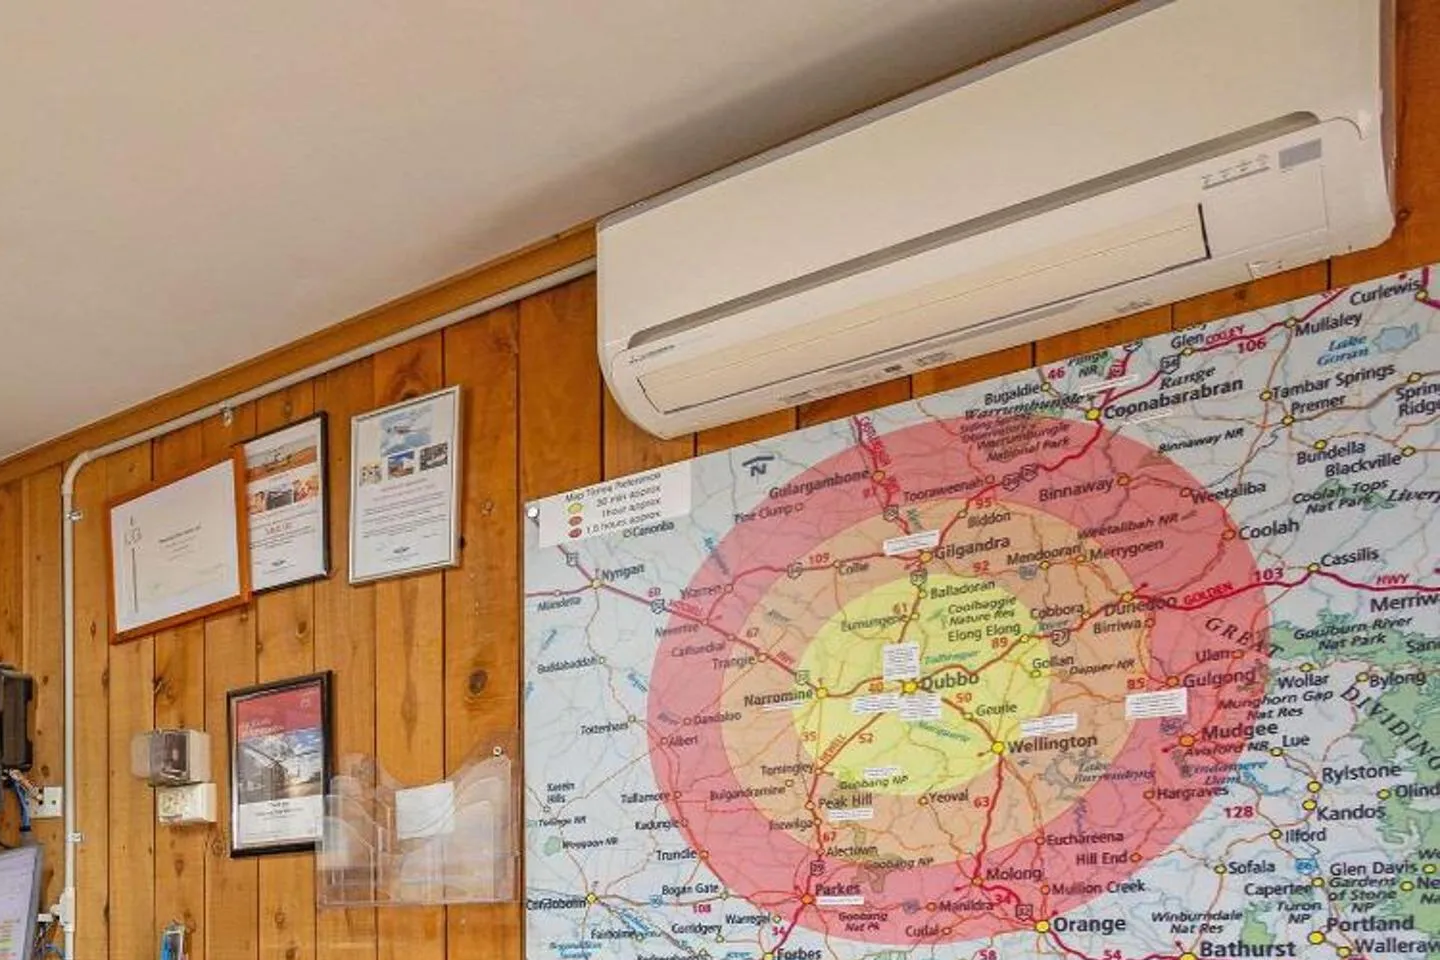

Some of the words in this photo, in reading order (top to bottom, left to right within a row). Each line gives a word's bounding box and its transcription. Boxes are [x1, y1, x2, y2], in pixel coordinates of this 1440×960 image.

[1349, 279, 1421, 306] Curlewis
[1295, 312, 1362, 337] Mullaley
[1170, 333, 1205, 351] Glen
[1238, 338, 1268, 354] 106
[1160, 366, 1216, 391] Range
[1272, 378, 1332, 401] Tambar
[1335, 362, 1396, 389] Springs
[983, 382, 1040, 406] Bugaldie
[1103, 378, 1244, 420] Coonabarabran
[1291, 394, 1347, 414] Premer
[1296, 442, 1366, 466] Bundella
[1325, 453, 1402, 478] Blackville
[768, 467, 872, 501] Gulargambone
[903, 476, 984, 502] Tooraweenah
[1038, 476, 1115, 502] Binnaway
[1191, 480, 1267, 505] Weetaliba
[1292, 488, 1343, 505] Coolah
[1346, 479, 1389, 495] Tops
[967, 511, 1012, 529] Biddon
[1238, 519, 1300, 541] Coolah
[932, 536, 1011, 560] Gilgandra
[1006, 542, 1083, 567] Mendooran
[1088, 538, 1165, 562] Merrygoen
[1320, 549, 1380, 568] Cassilis
[601, 563, 645, 583] Nyngan
[1253, 568, 1284, 583] 103
[1376, 573, 1409, 585] HWY
[929, 580, 996, 600] Balladoran
[1029, 603, 1084, 621] Cobbora
[1103, 597, 1178, 618] Dunedoo
[1093, 618, 1143, 635] Birriwa
[1372, 615, 1415, 631] River
[948, 629, 982, 643] Elong
[985, 623, 1022, 638] Elong
[1351, 632, 1387, 648] Park
[991, 636, 1009, 649] 89
[712, 655, 756, 671] Trangie
[1032, 654, 1075, 669] Gollan
[1195, 647, 1232, 664] Ulan
[921, 672, 980, 691] Dubbo
[1182, 667, 1257, 689] Gulgong
[1278, 673, 1329, 689] Wollar
[1369, 669, 1427, 690] Bylong
[744, 689, 813, 707] Narromine
[1217, 694, 1298, 711] Munghorn
[1303, 689, 1333, 703] Gap
[976, 702, 1018, 716] Geurie
[1247, 708, 1274, 721] Nat
[1277, 706, 1304, 719] Res
[1201, 720, 1279, 742] Mudgee
[1008, 732, 1098, 755] Wellington
[1282, 734, 1311, 749] Lue
[1322, 762, 1402, 784] Rylstone
[851, 793, 873, 806] Hill
[929, 789, 970, 803] Yeoval
[1157, 786, 1230, 800] Hargraves
[1224, 806, 1255, 820] 128
[1316, 804, 1388, 822] Kandos
[1046, 830, 1125, 846] Euchareena
[1286, 826, 1328, 844] Ilford
[657, 848, 697, 861] Trundle
[1076, 852, 1098, 866] Hill
[1101, 851, 1128, 865] End
[986, 867, 1042, 884] Molong
[1227, 860, 1276, 875] Sofala
[1329, 861, 1367, 877] Glen
[1372, 860, 1418, 875] Davis
[661, 884, 694, 898] Bogan
[695, 883, 719, 895] Gate
[814, 882, 861, 897] Parkes
[1051, 881, 1104, 897] Mullion
[1107, 879, 1146, 894] Creek
[1328, 876, 1397, 889] Gardens
[1350, 888, 1398, 901] Stone
[939, 900, 994, 912] Manildra
[1276, 900, 1322, 913] Turon
[1351, 901, 1375, 914] NP
[1053, 916, 1127, 937] Orange
[1151, 910, 1244, 925] Winburndale
[1288, 912, 1310, 925] NP
[1326, 914, 1416, 933] Portland
[905, 925, 940, 938] Cudal
[1170, 922, 1196, 936] Nat
[1198, 922, 1225, 936] Res
[1199, 941, 1297, 959] Bathurst
